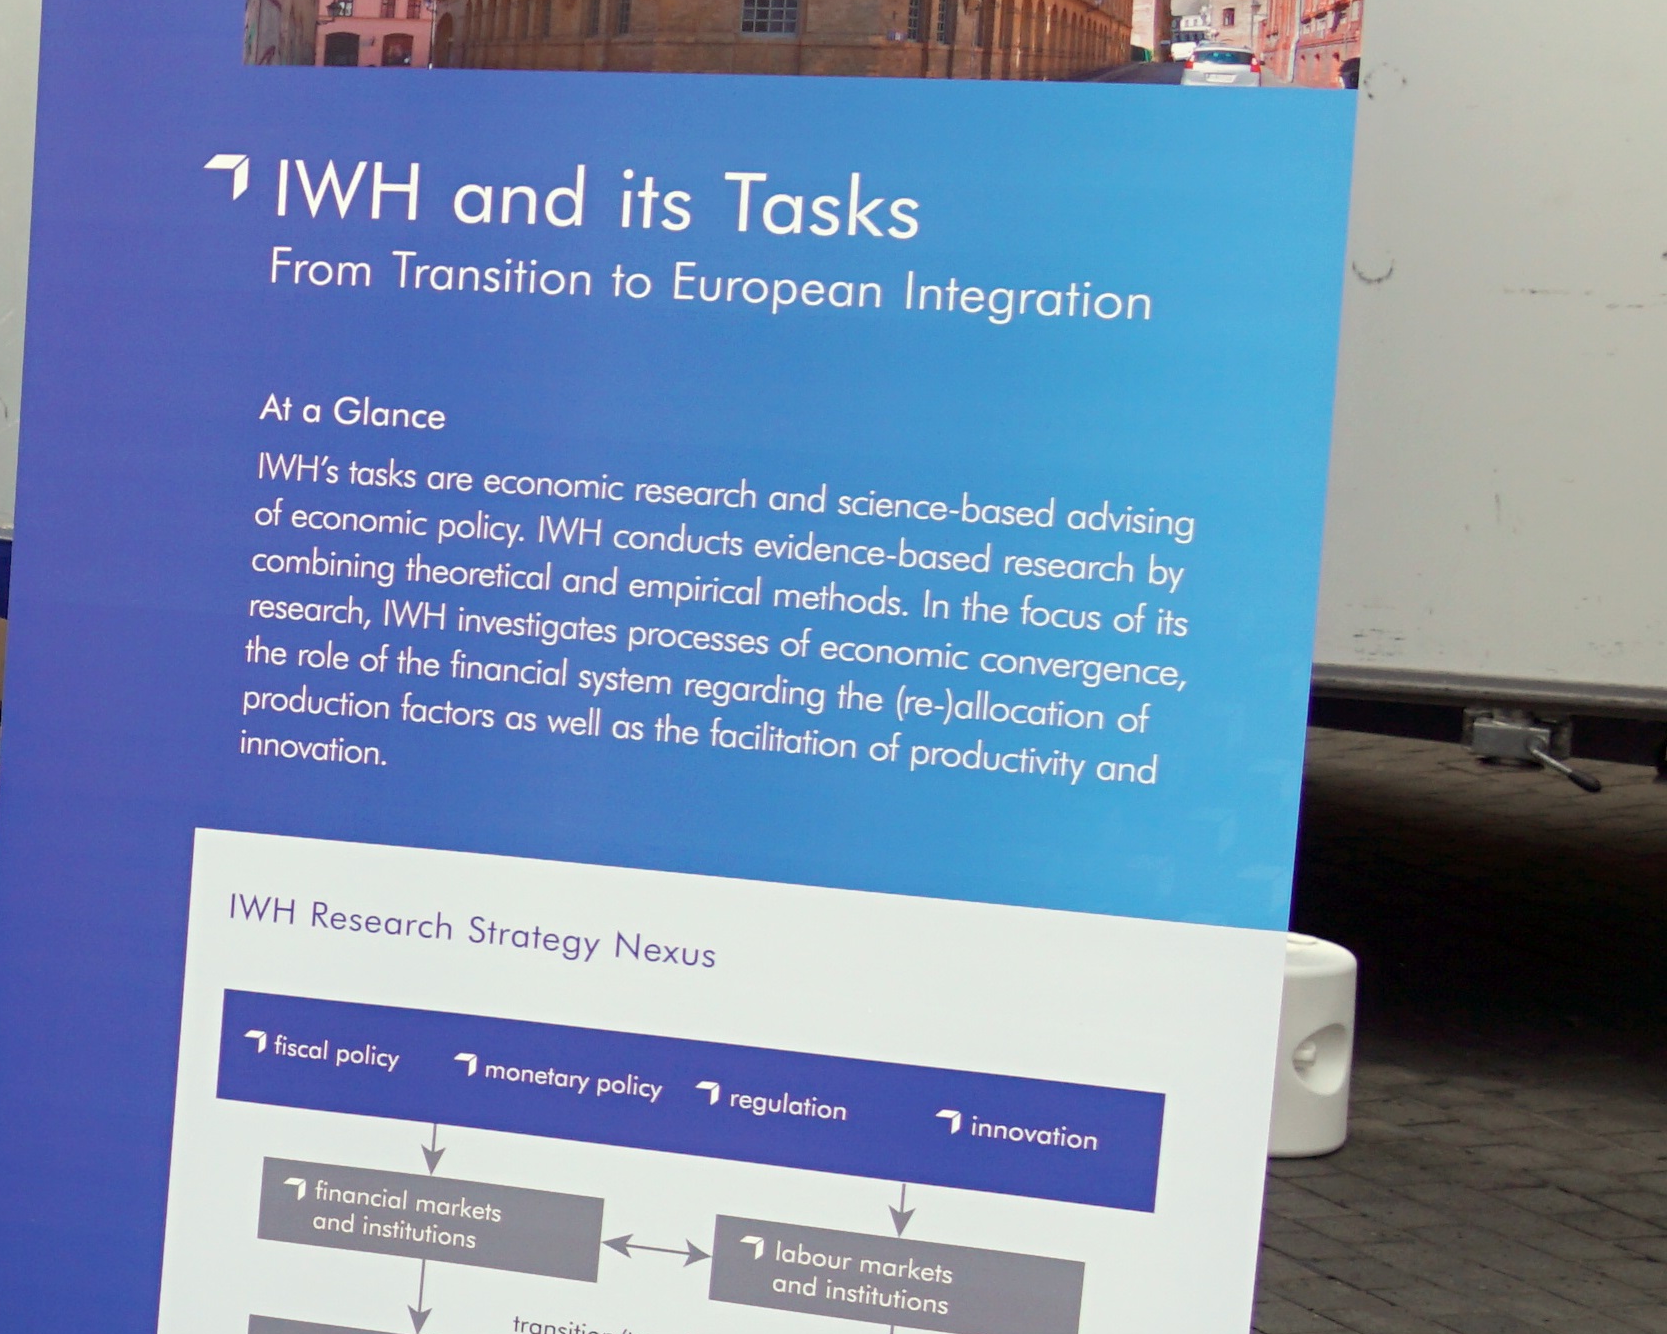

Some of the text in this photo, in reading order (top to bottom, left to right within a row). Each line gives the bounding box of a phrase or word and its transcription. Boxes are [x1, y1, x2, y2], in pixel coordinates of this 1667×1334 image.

[278, 159, 919, 239] IWH and its Tasks
[271, 246, 1150, 324] From Transition to European Integration
[259, 393, 445, 429] At a Glance
[259, 452, 1194, 543] IWH's tasks are economic research and science-based advising
[231, 893, 715, 968] IWH Research Strategy Nexus
[274, 1034, 399, 1072] fiscal policy
[485, 1065, 662, 1103] monetary policy
[731, 1092, 846, 1120] regulation
[972, 1116, 1097, 1150] innovation
[315, 1180, 501, 1222] financial markets
[313, 1213, 476, 1248] and institutions
[776, 1240, 952, 1284] labour markets
[773, 1276, 948, 1314] and institutions
